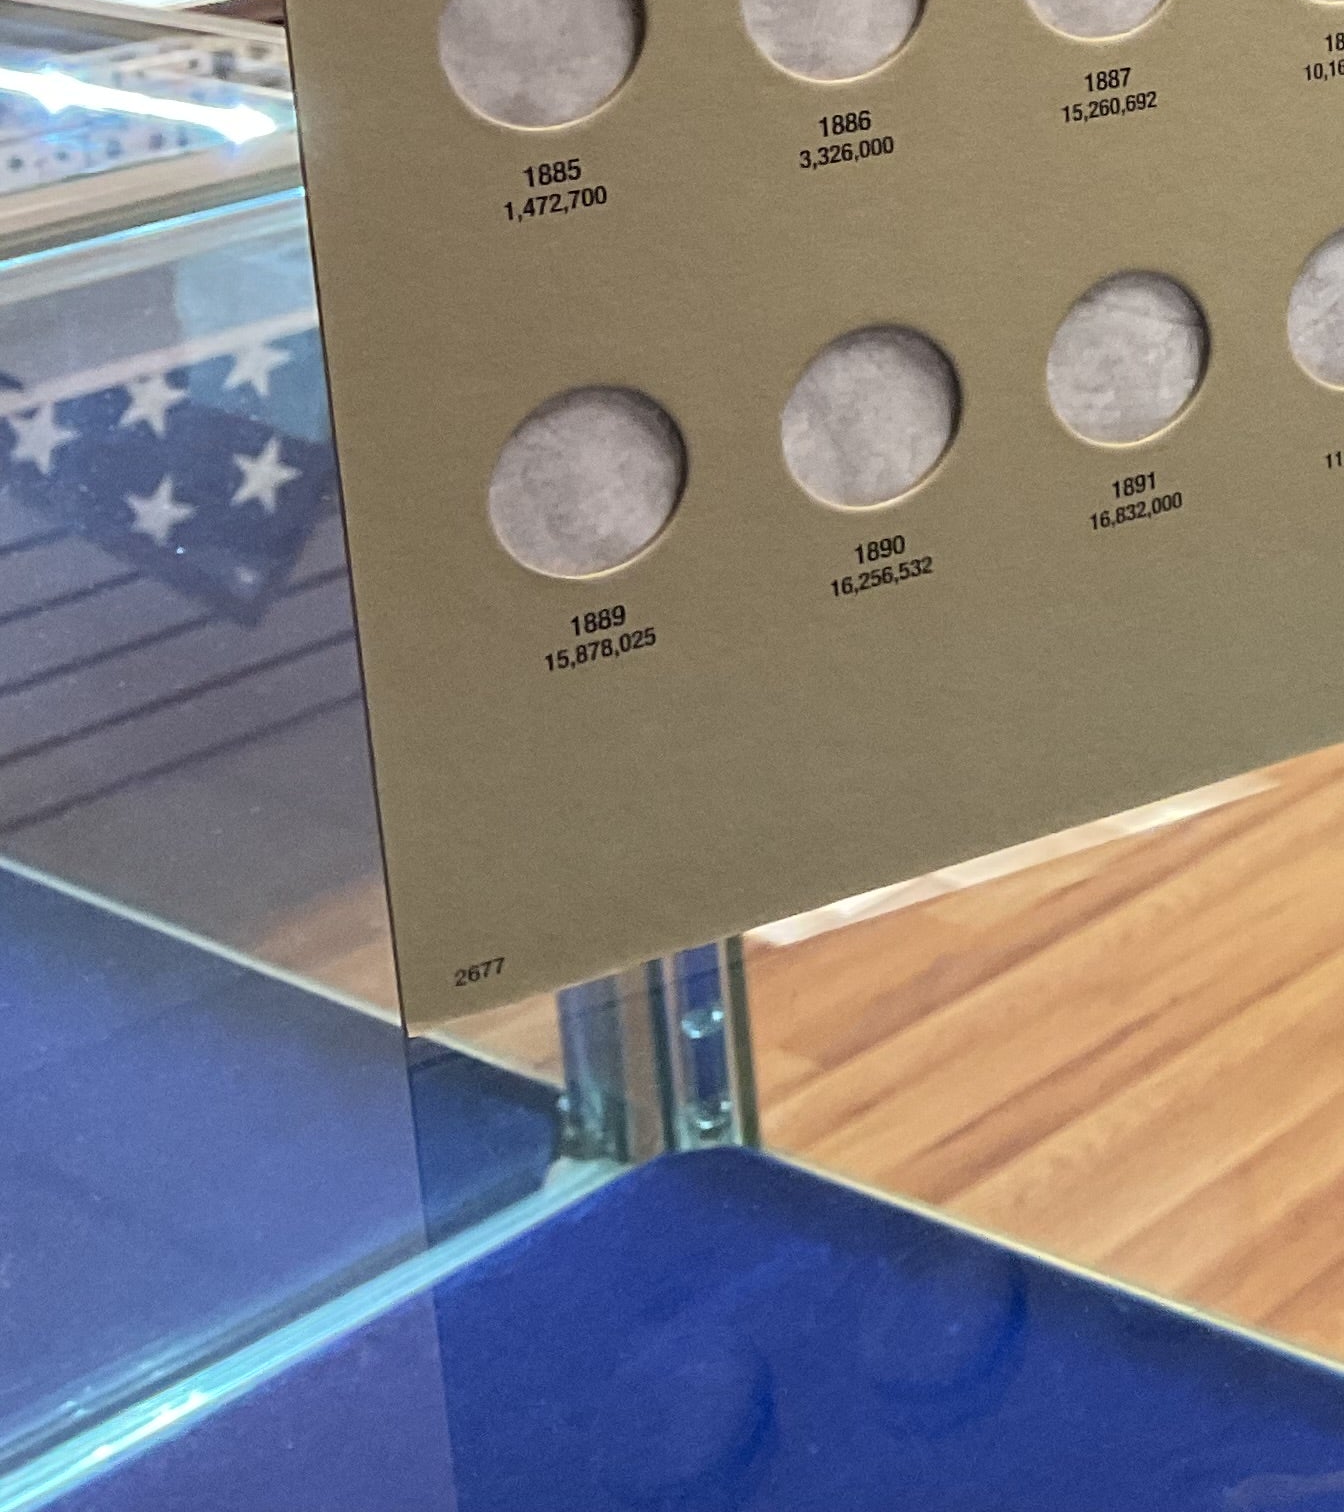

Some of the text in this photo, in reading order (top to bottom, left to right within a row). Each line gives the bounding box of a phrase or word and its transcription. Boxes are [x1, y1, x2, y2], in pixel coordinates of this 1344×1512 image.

[1085, 66, 1132, 93] 1887
[819, 109, 872, 138] 1886
[1062, 91, 1158, 124] 15,260,692
[799, 136, 896, 170] 3,326,000
[522, 159, 582, 189] 1885
[504, 186, 608, 224] 1,472,700
[1111, 472, 1157, 501] 1891
[1090, 493, 1184, 531] 16,832,000
[855, 534, 907, 566] 1890
[830, 556, 935, 598] 16,256,532
[571, 605, 626, 638] 1889
[545, 629, 656, 672] 15,878,025
[454, 957, 506, 988] 2677
